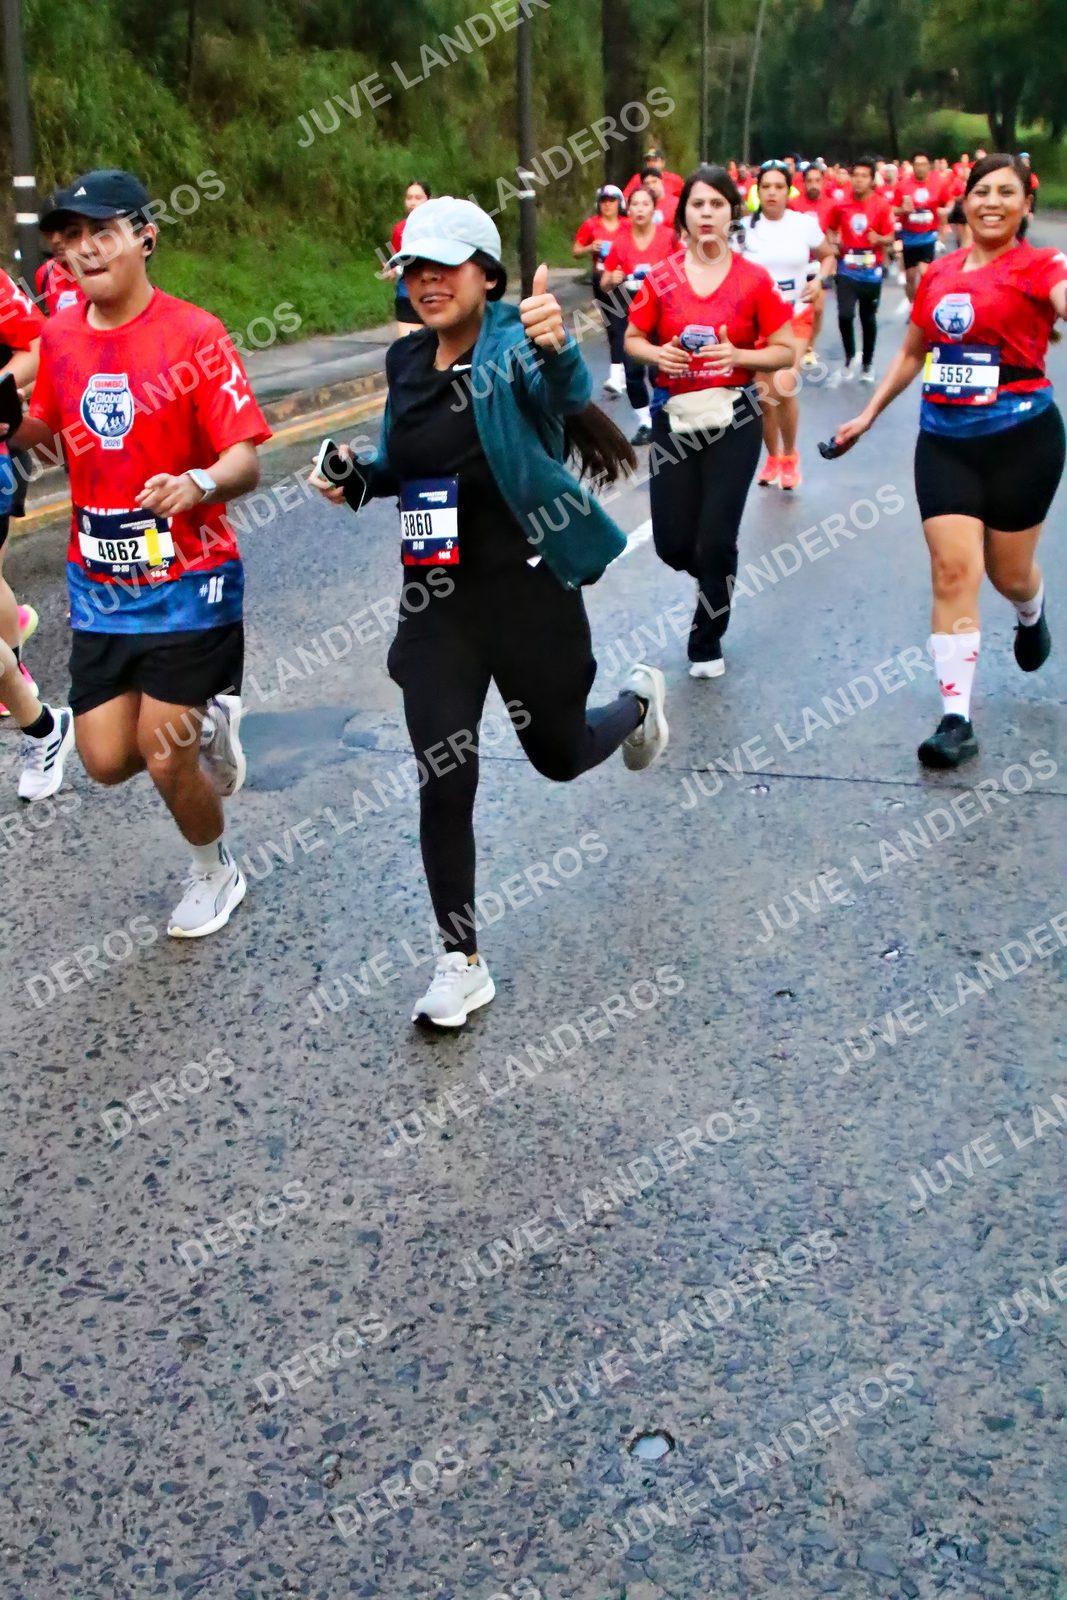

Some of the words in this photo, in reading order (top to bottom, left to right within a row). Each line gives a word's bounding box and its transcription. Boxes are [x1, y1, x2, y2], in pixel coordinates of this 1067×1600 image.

[939, 366, 973, 384] 5552
[94, 392, 123, 404] Global
[89, 403, 114, 414] Race
[403, 512, 433, 537] 3860
[98, 540, 142, 561] 4862
